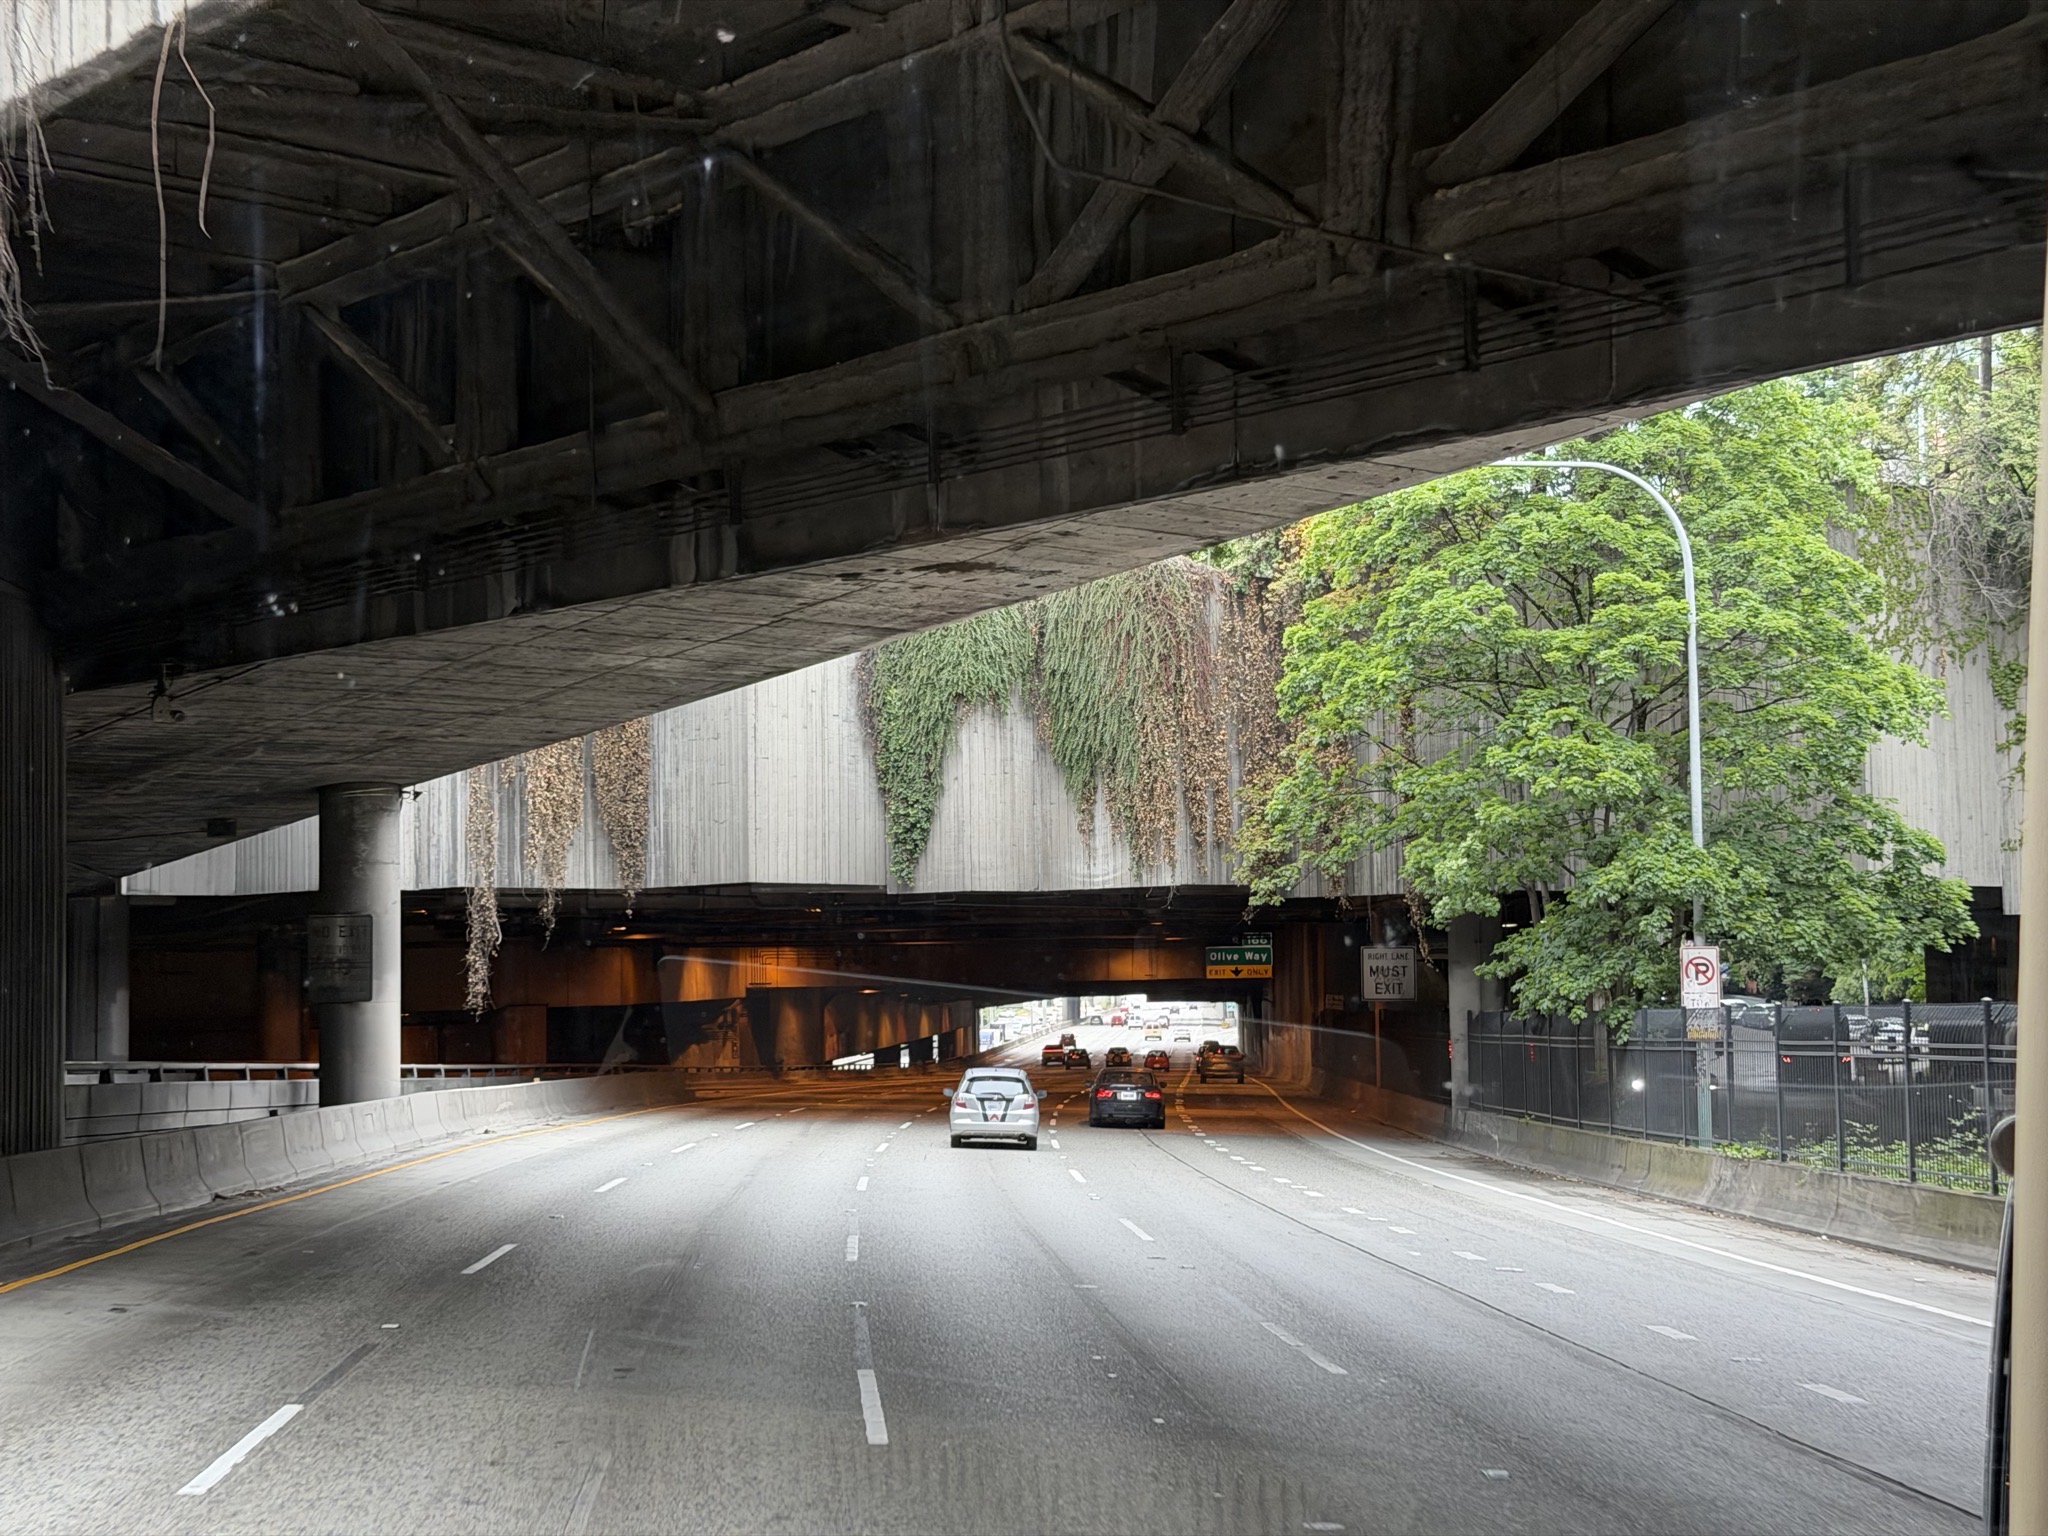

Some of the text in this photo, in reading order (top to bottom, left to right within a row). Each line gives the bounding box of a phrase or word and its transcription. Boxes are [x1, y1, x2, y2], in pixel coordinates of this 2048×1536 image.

[1209, 951, 1268, 963] Olive Way
[1367, 952, 1409, 960] RIGHT LANE
[1208, 968, 1269, 976] EXIT ONLY
[1369, 965, 1408, 978] MUST
[1375, 982, 1403, 995] EXIT
